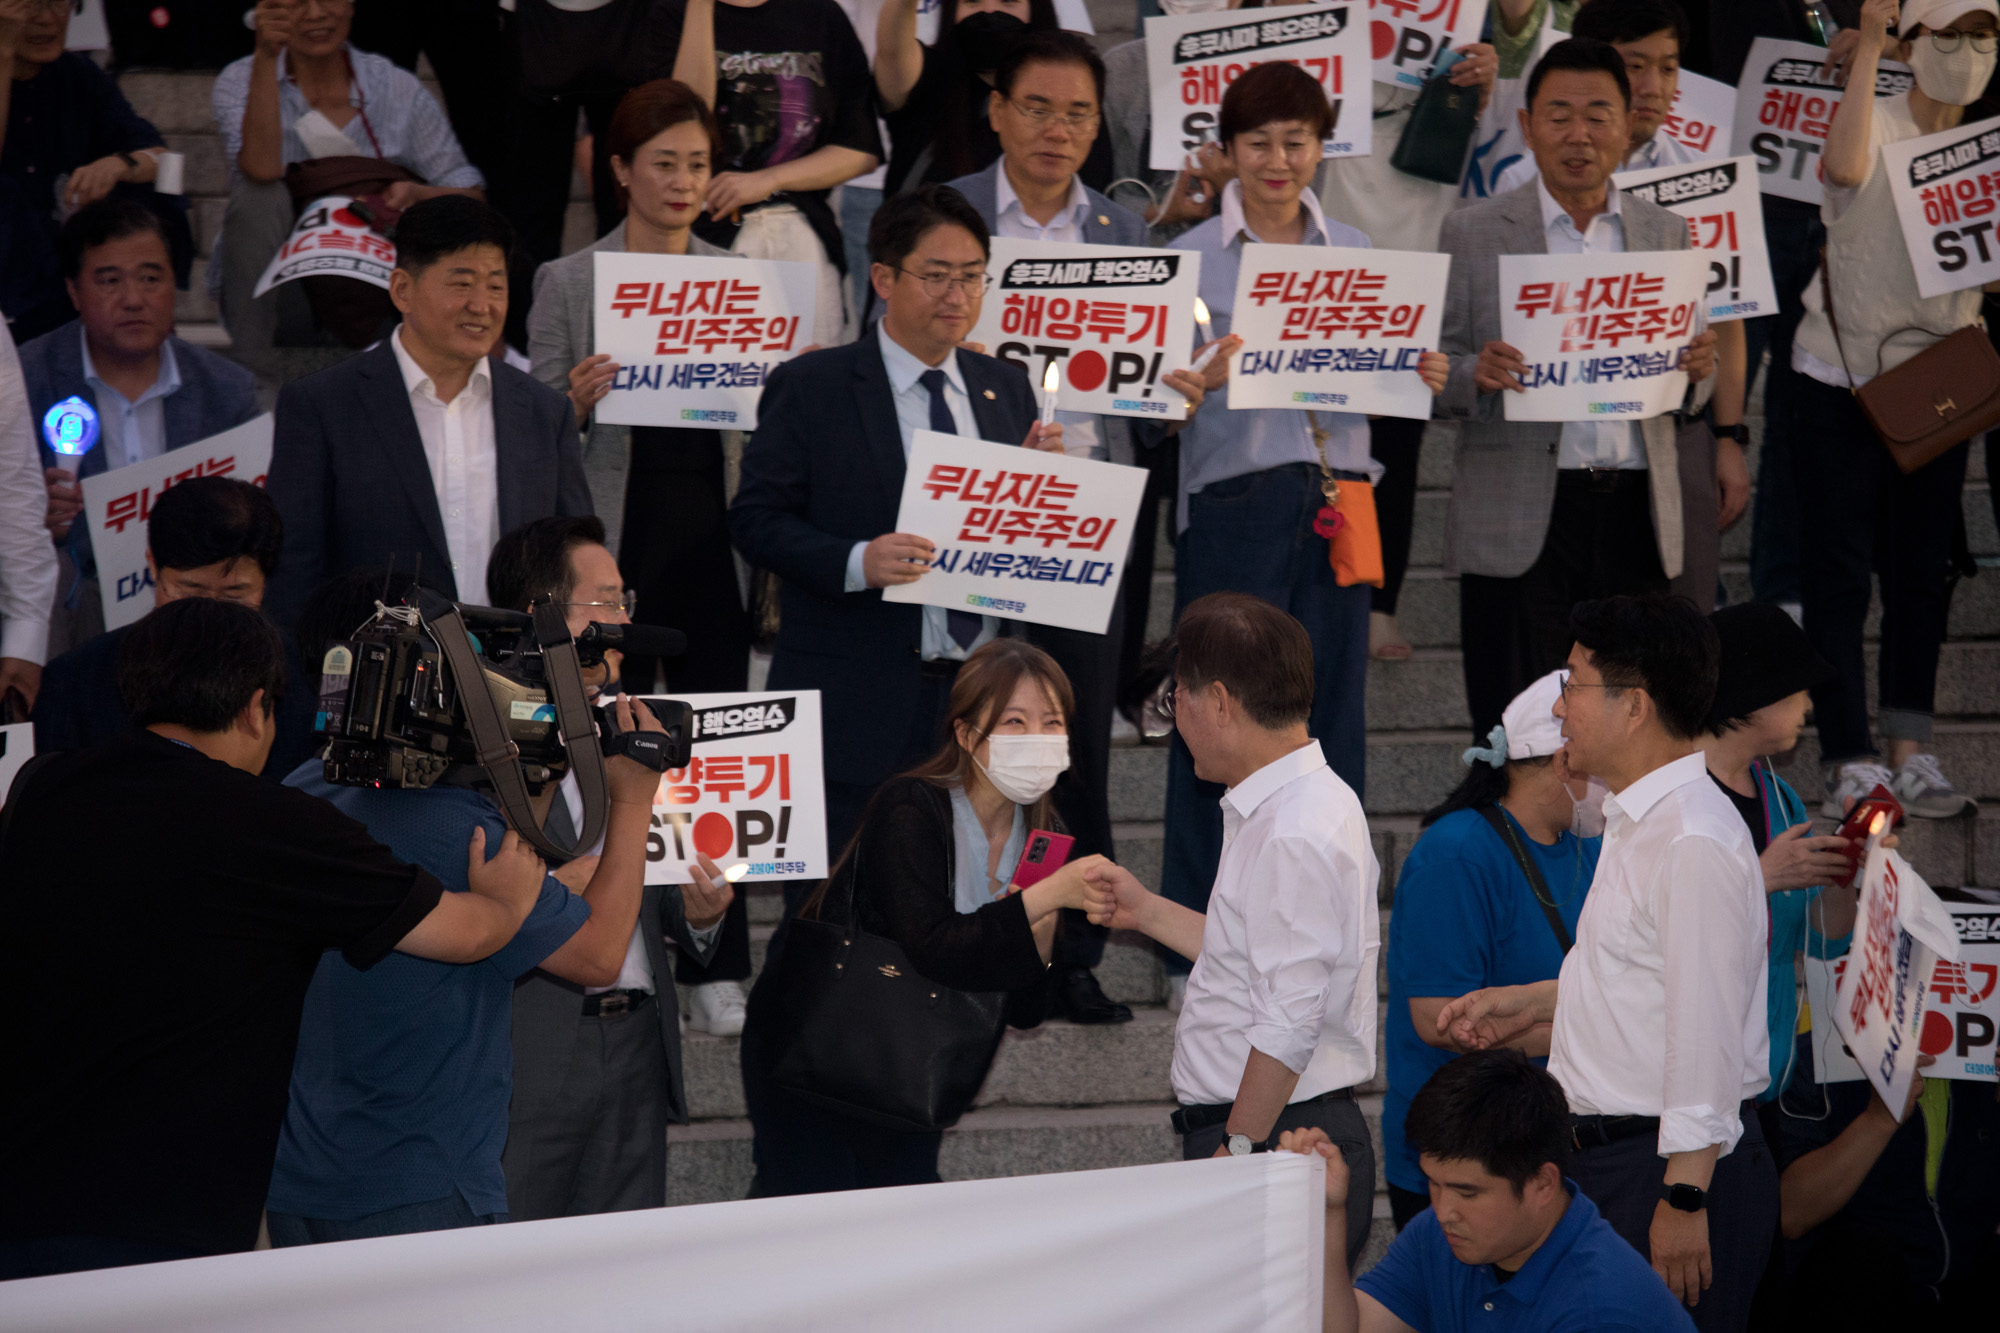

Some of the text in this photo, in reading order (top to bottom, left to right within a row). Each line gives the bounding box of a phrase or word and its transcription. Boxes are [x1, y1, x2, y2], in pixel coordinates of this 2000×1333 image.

[1178, 13, 1340, 58] 후쿠시마 핵오염수
[1913, 140, 1981, 181] 후쿠시마
[1658, 168, 1731, 203] 핵오염수
[1008, 260, 1170, 284] 후쿠시마 핵오염수
[1248, 268, 1388, 307] 무너지는
[610, 279, 761, 318] 무너지는
[1514, 272, 1665, 319] 무너지는
[655, 316, 799, 355] 민주주의
[1001, 293, 1169, 348] 해양투기
[1279, 304, 1427, 341] 민주주의
[1559, 301, 1696, 353] 민주주의
[611, 364, 663, 391] 다시
[1240, 350, 1285, 376] 다시
[1519, 361, 1568, 389] 다시
[680, 408, 737, 423] 더불어민주당
[1112, 399, 1168, 413] 더불어민주당
[1291, 391, 1349, 405] 더불어민주당
[921, 464, 1079, 511] 무너지는
[957, 507, 1118, 551] 민주주의
[960, 551, 1114, 587] 세우겠습니다
[966, 594, 1027, 614] 더불어민주당
[702, 704, 787, 736] 핵오염수
[634, 739, 659, 750] Canon
[652, 754, 791, 805] 양투기
